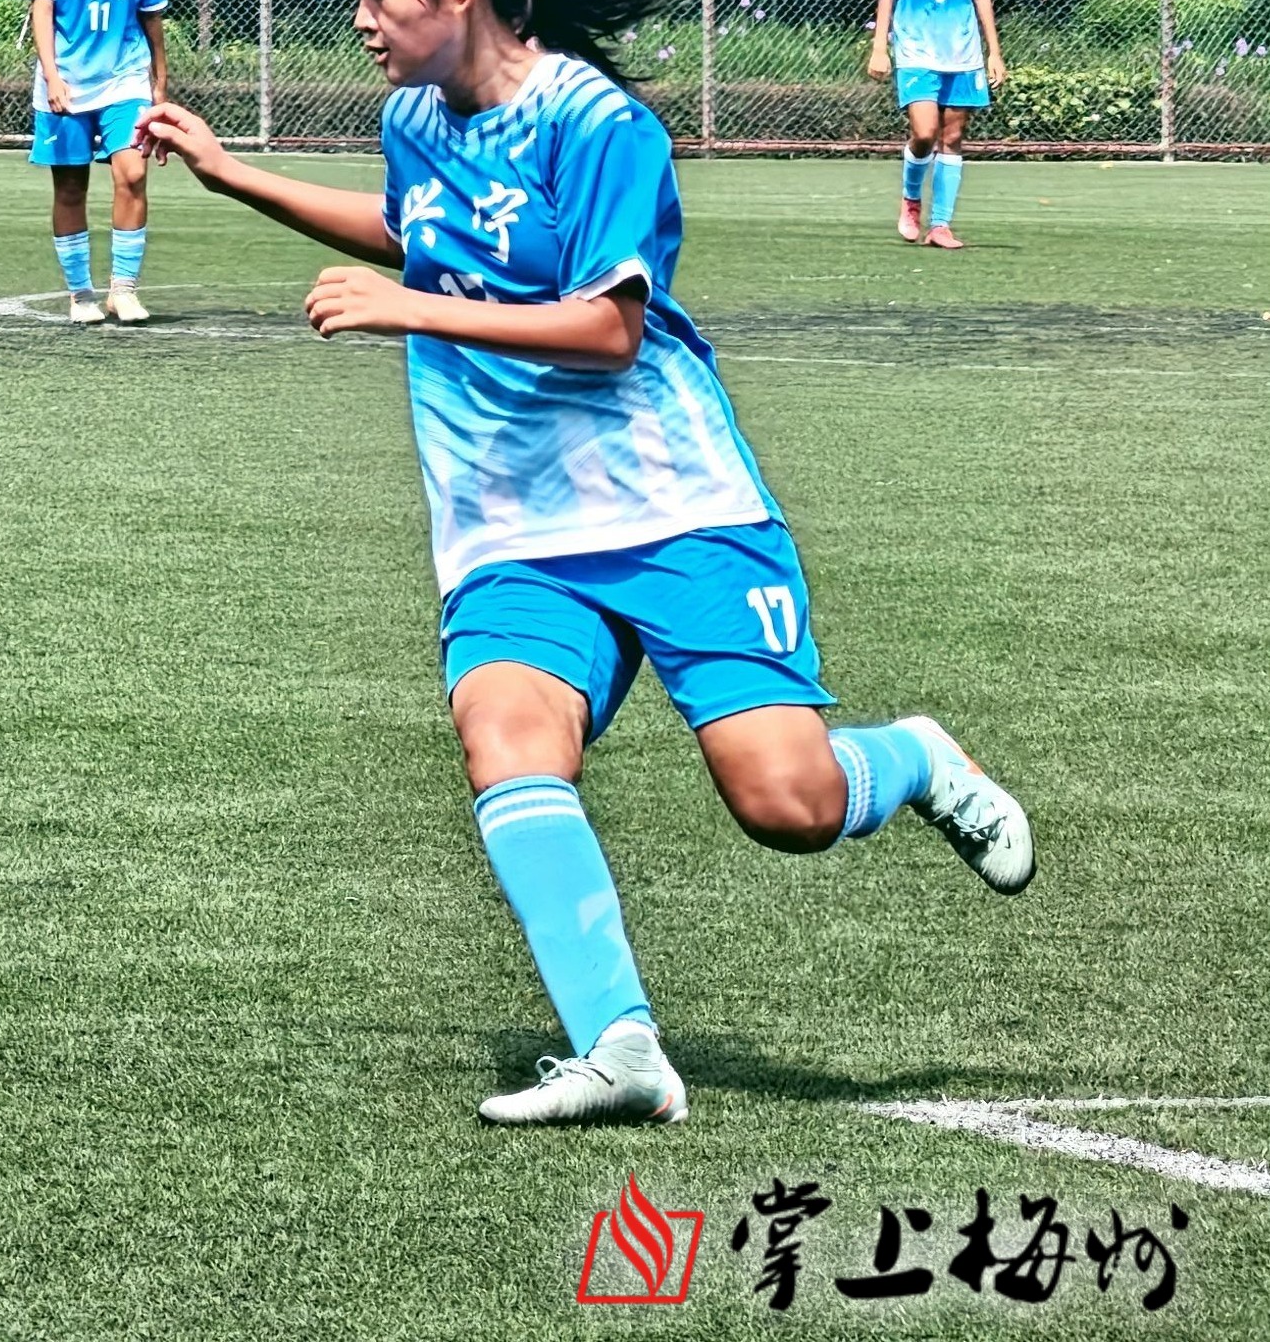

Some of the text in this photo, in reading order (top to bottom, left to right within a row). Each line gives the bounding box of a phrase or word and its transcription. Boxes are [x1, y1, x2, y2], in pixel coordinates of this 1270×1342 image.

[87, 1, 111, 31] 11
[400, 177, 529, 264] 兴宁
[746, 585, 798, 653] 17
